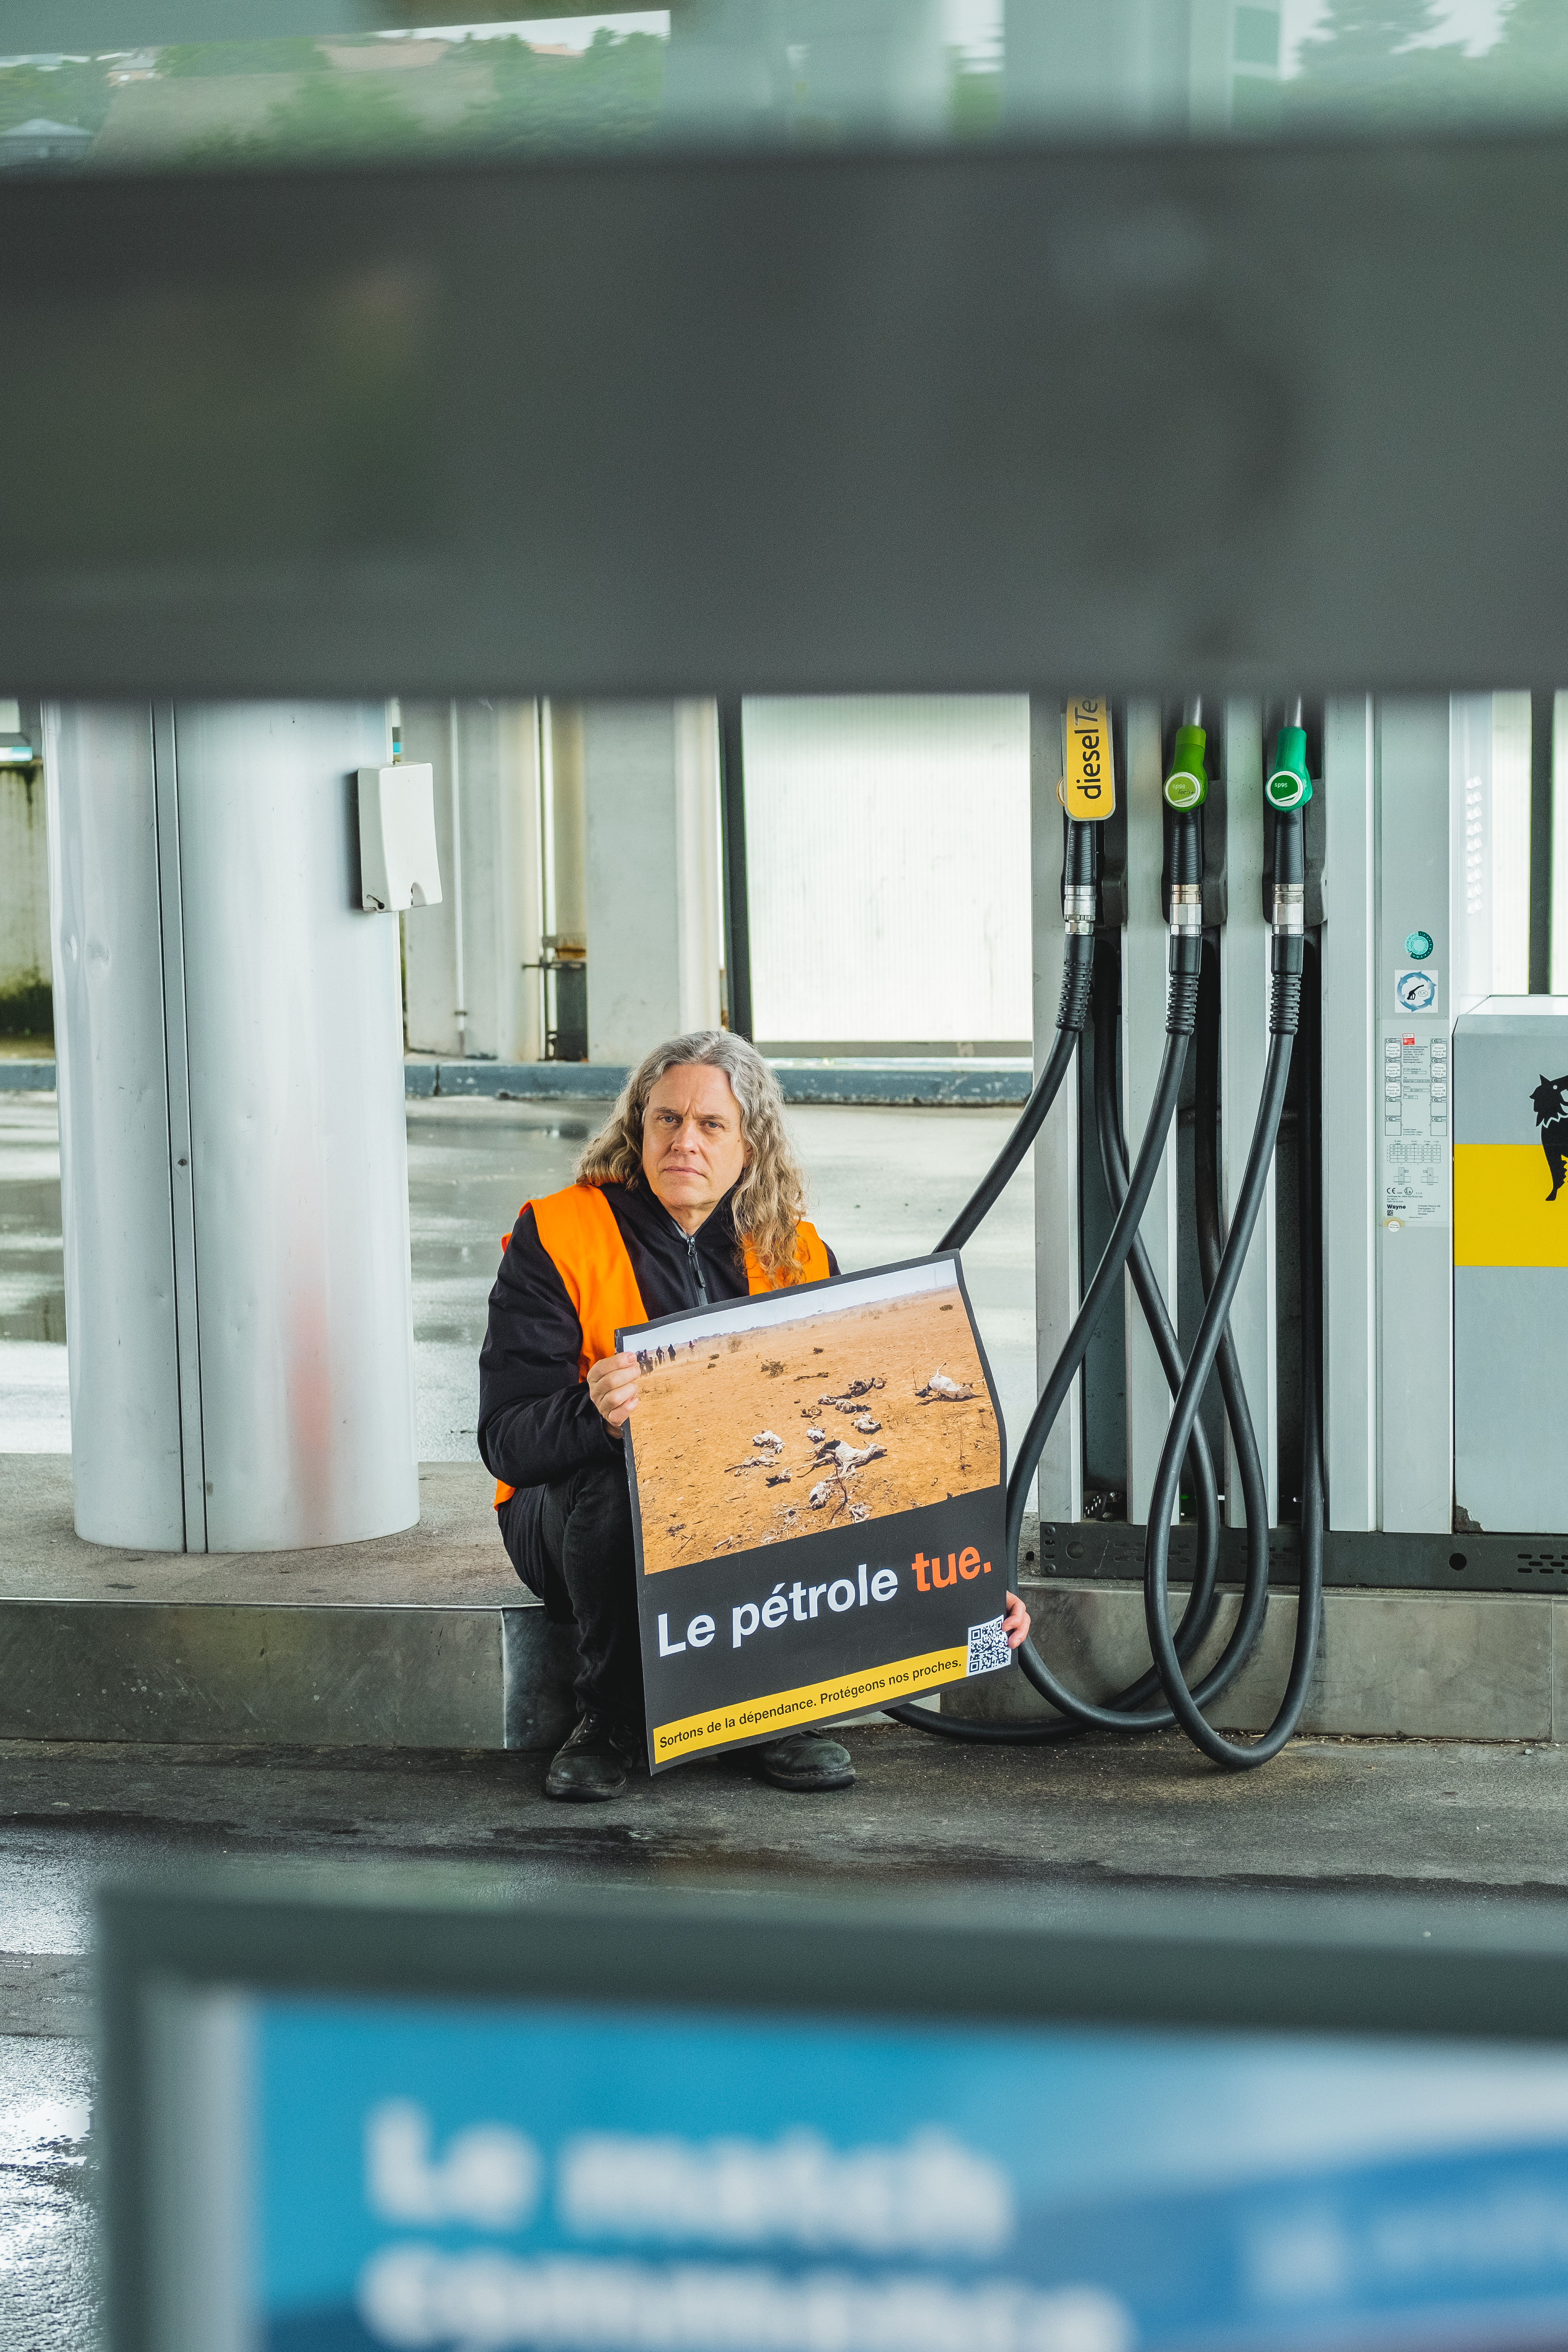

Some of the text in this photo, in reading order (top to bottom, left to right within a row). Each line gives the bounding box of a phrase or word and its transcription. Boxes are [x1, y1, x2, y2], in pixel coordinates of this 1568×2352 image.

[1074, 729, 1102, 799] diesel
[658, 1546, 991, 1657] Le pétrole tue.
[660, 1659, 962, 1748] Sortons de la dépendance. Protégeons nos proches.
